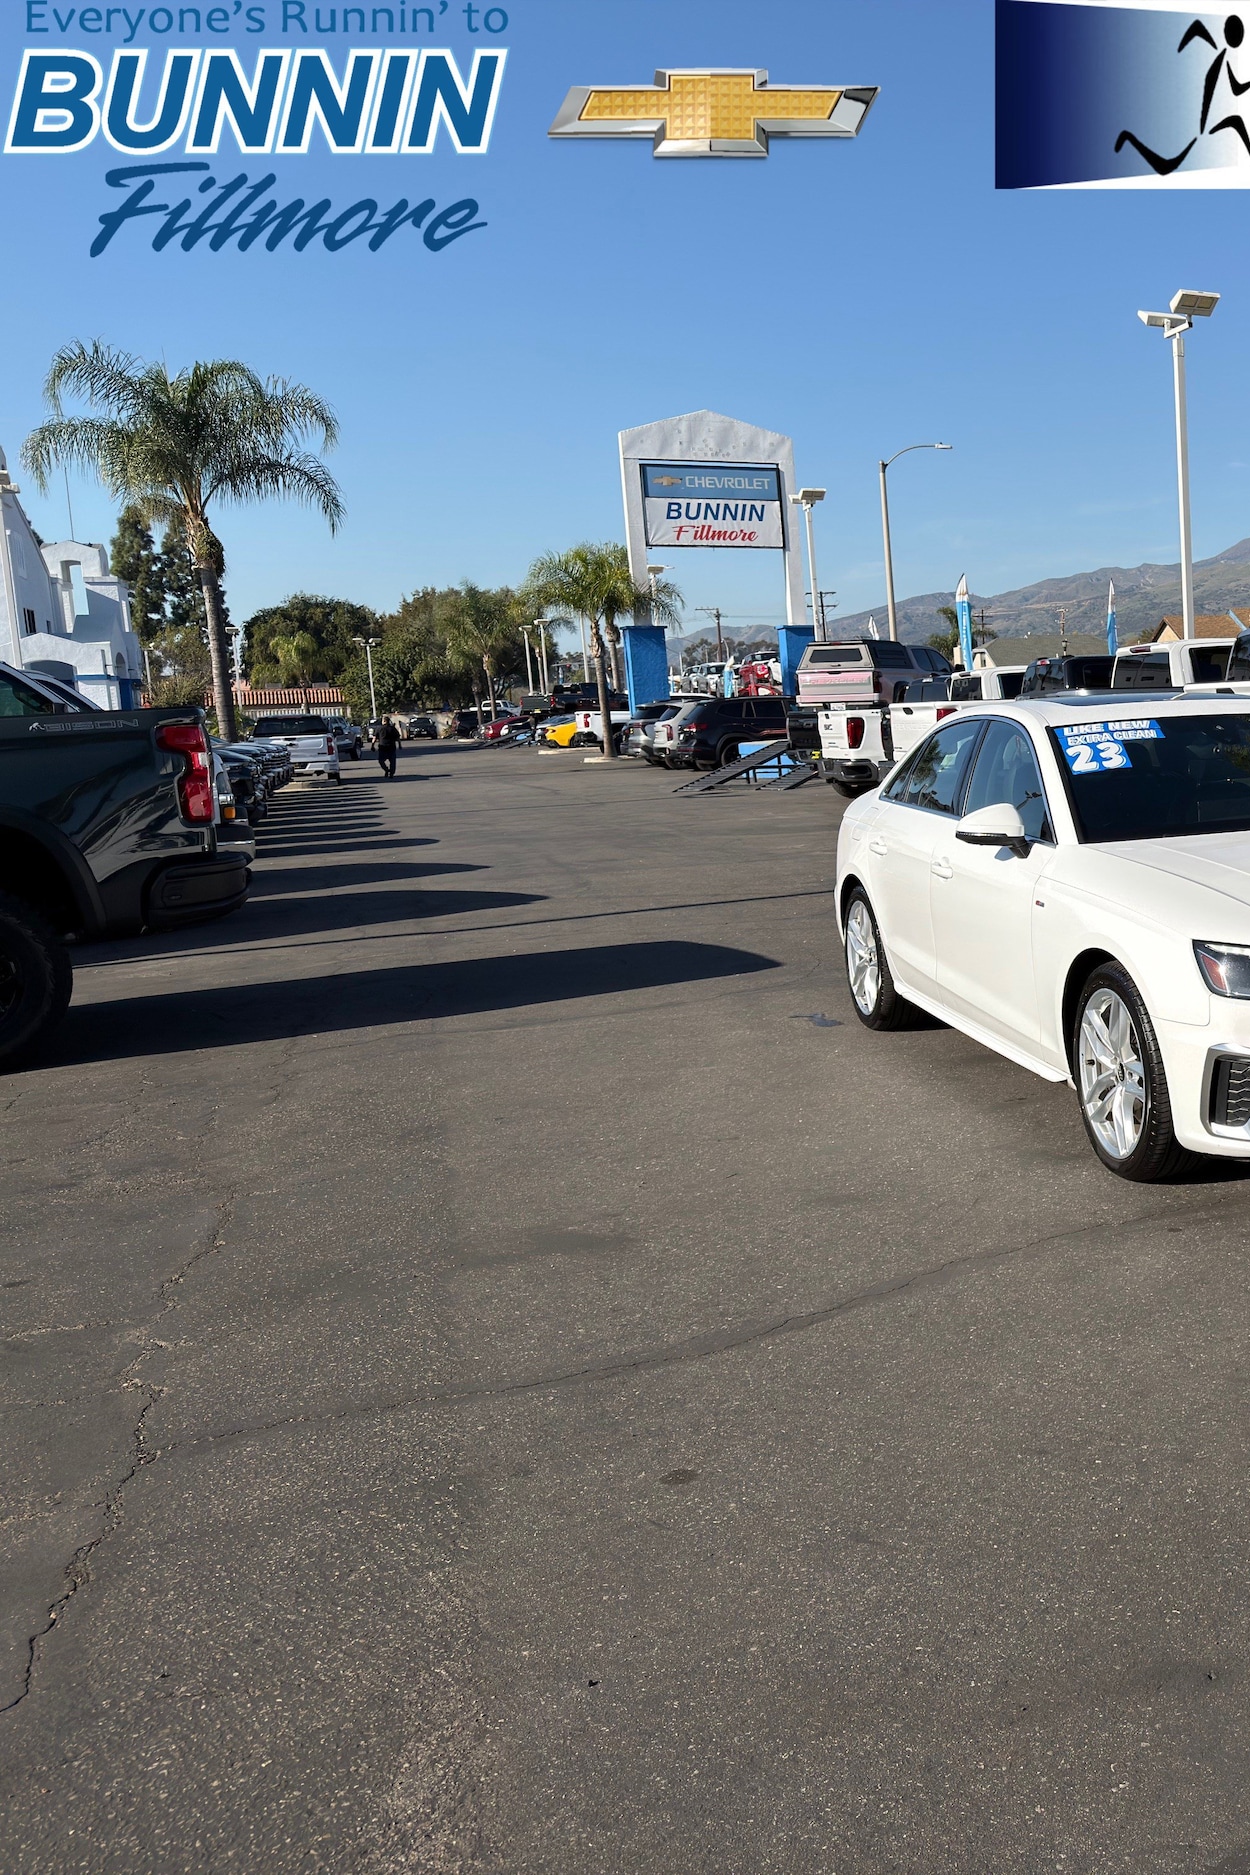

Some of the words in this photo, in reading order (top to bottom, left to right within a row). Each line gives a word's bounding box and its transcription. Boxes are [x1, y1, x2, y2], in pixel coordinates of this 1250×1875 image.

[685, 475, 770, 490] CHEVROLET
[666, 502, 765, 522] BUNNIN
[672, 524, 759, 542] Fillmore
[44, 719, 139, 732] BISON
[1063, 722, 1105, 736] LIKE
[1108, 720, 1151, 731] NEW
[1067, 732, 1113, 746] EXTRA
[1113, 730, 1157, 741] CLEAN
[1065, 742, 1127, 774] 23
